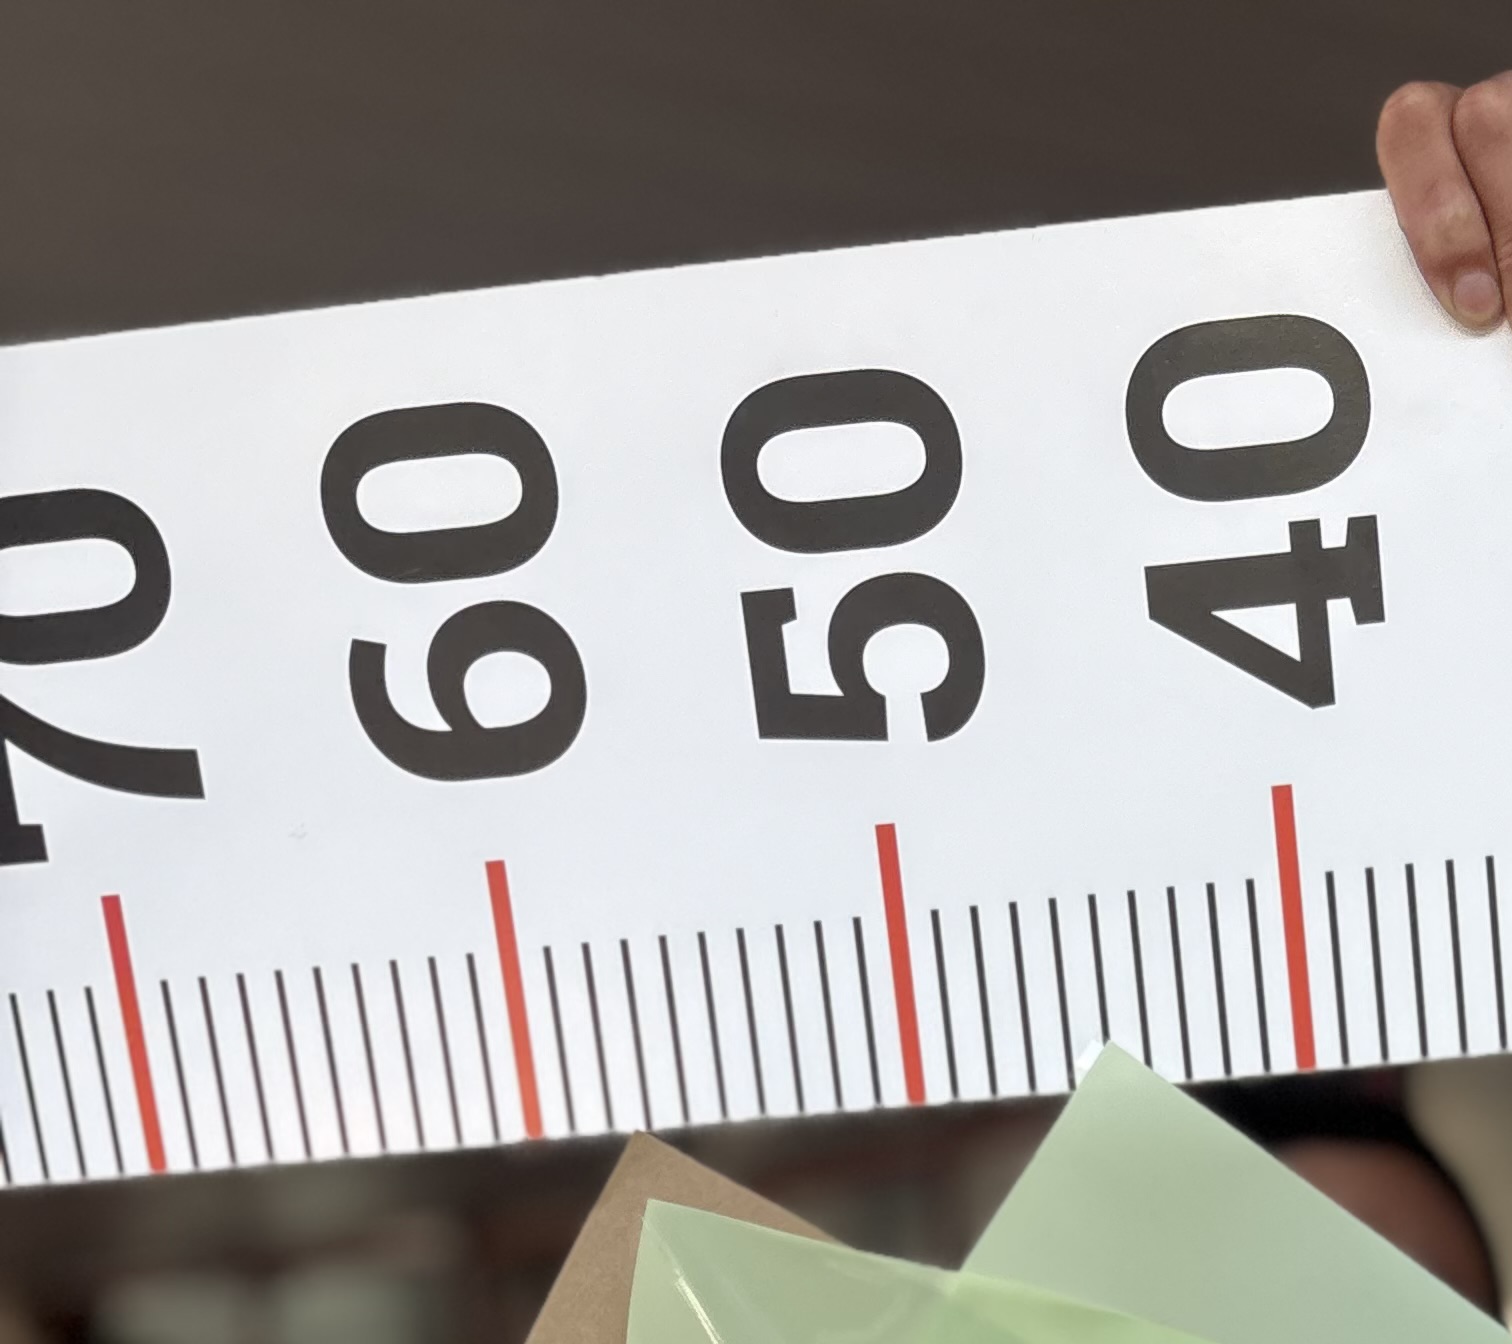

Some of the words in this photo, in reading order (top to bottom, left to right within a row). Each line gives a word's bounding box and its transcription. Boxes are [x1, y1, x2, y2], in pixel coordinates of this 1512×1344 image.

[0, 488, 205, 866] 70
[320, 402, 587, 781] 60
[720, 368, 985, 741] 50
[1125, 314, 1385, 708] 40
